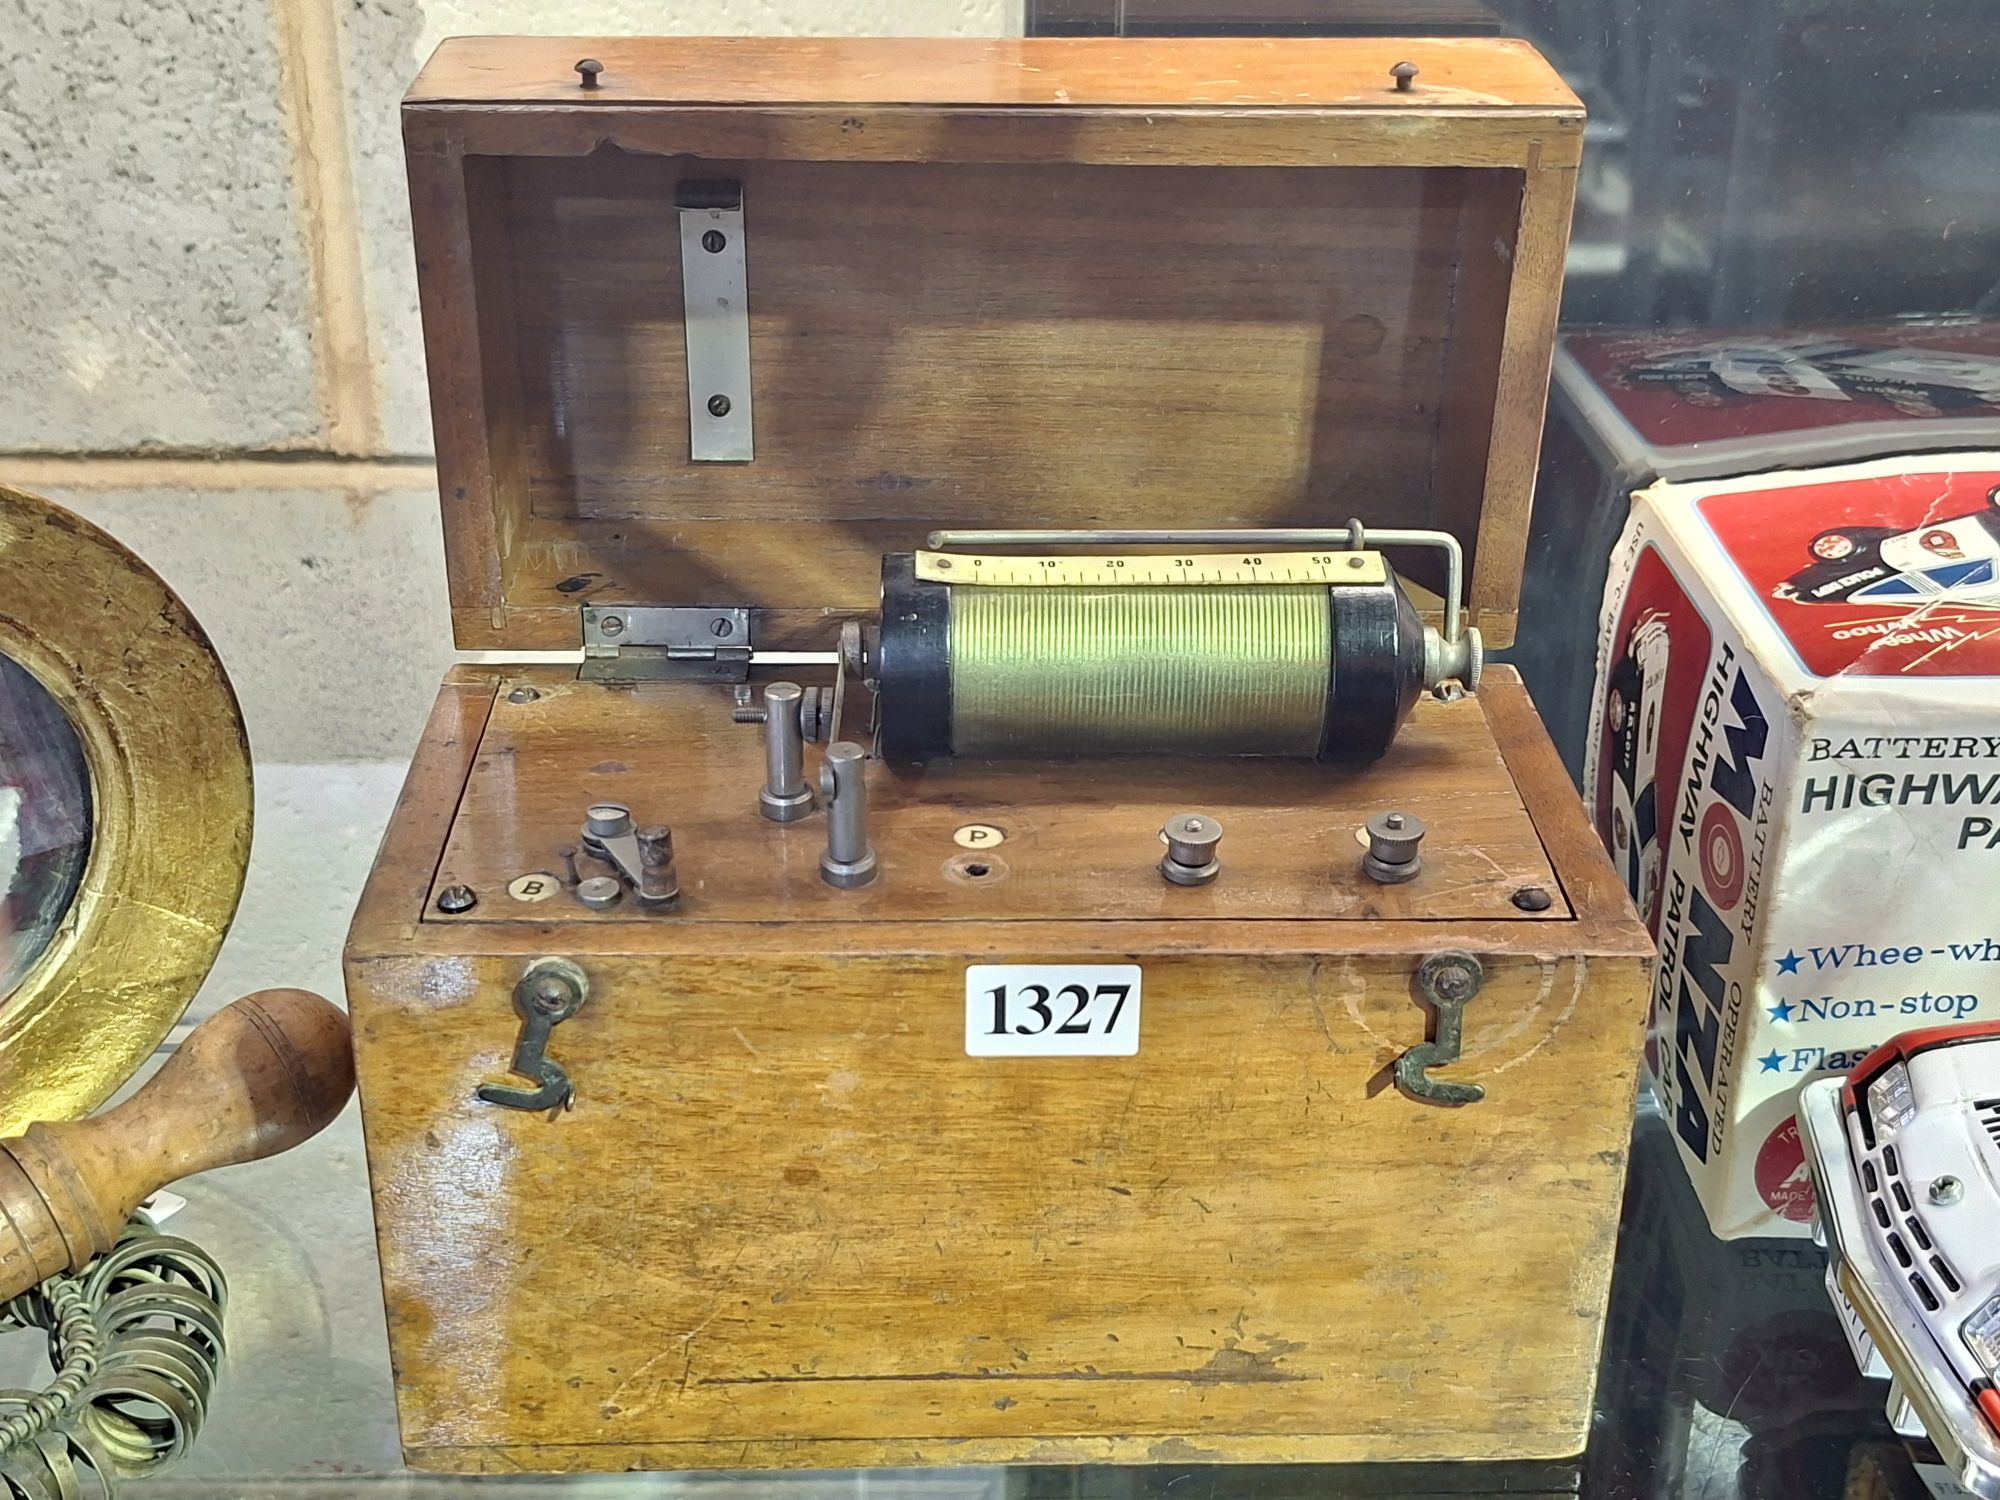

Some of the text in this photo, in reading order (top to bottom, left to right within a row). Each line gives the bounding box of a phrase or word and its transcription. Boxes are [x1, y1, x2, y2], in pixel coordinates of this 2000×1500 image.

[1628, 522, 1644, 557] USE
[974, 556, 1332, 568] 0 10 20 30 40 50
[1807, 737, 2000, 762] BATTERY
[969, 830, 988, 842] P
[521, 881, 544, 895] B
[1658, 641, 1735, 1118] HIGHWAY PATROL CAR
[1712, 776, 1774, 1156] BATTERY OPERATED
[984, 984, 1132, 1035] 1327
[1796, 991, 1979, 1023] Non-stop
[1788, 1045, 1880, 1072] Flas
[1771, 1191, 1806, 1201] MADE
